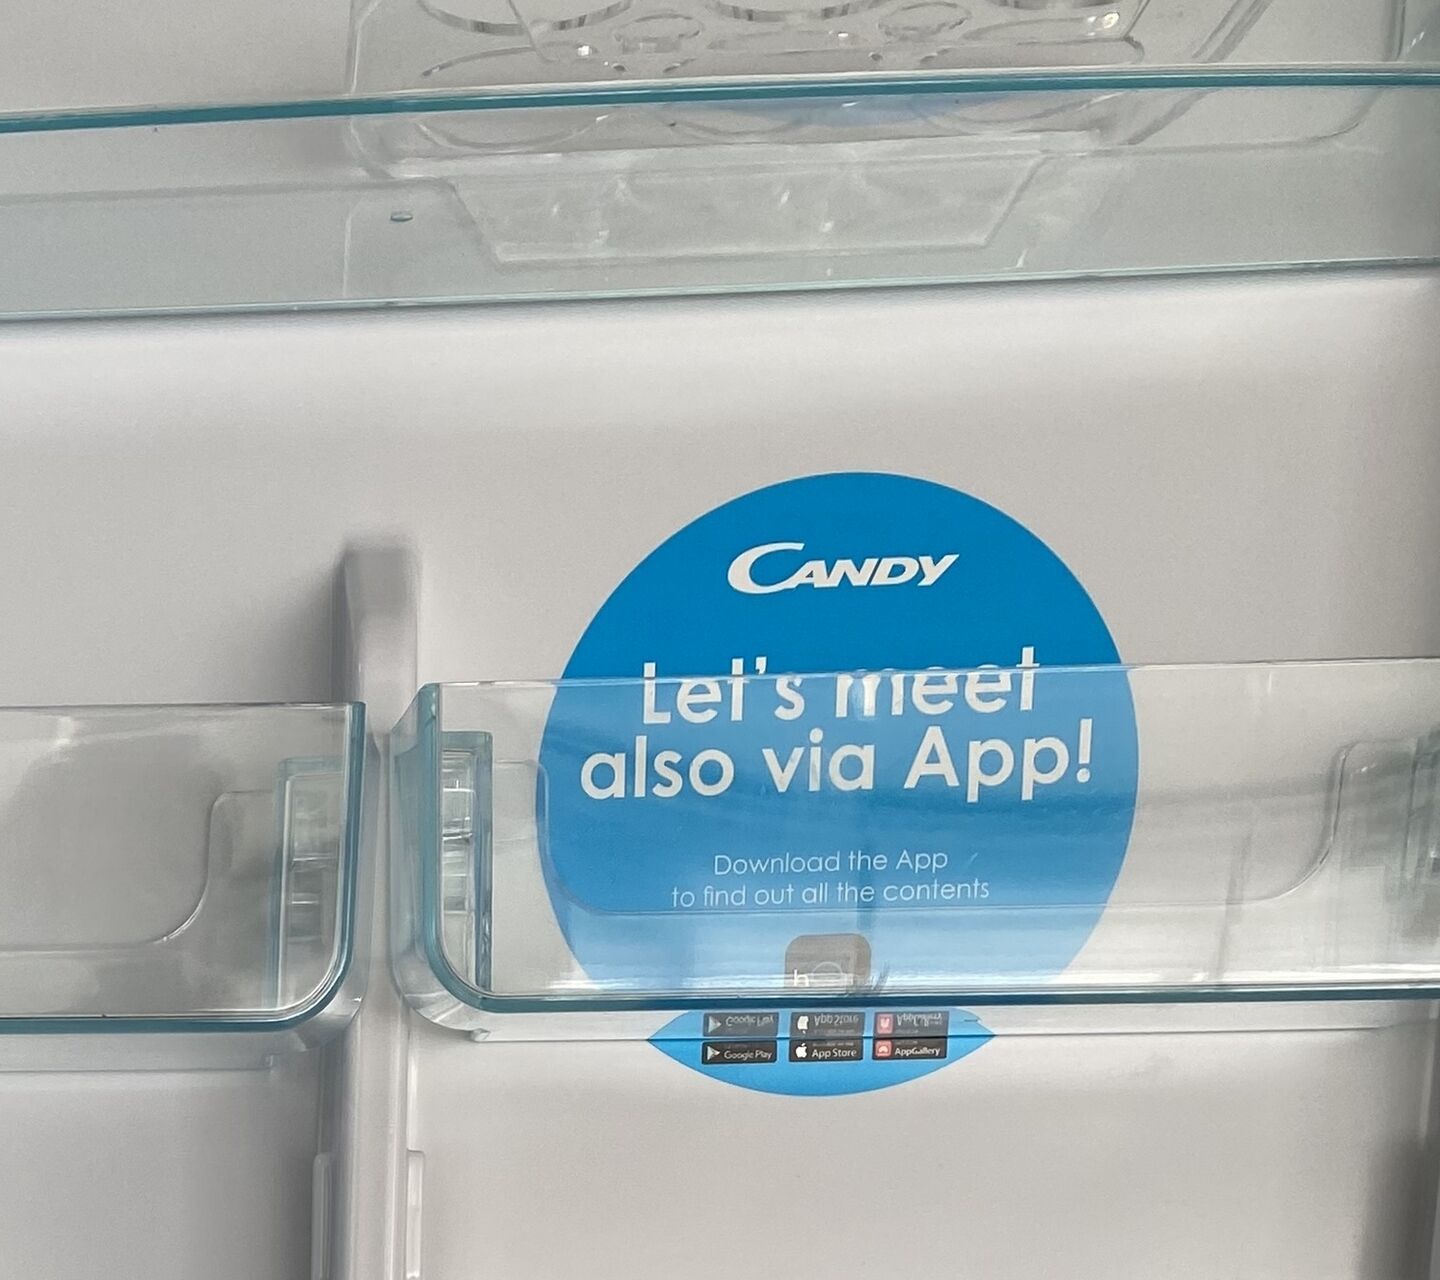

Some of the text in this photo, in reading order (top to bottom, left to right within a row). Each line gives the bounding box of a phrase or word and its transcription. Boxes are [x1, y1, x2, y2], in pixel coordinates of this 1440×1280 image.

[727, 542, 960, 595] CANDY
[643, 646, 1040, 725] Let's meet
[580, 718, 1093, 803] also via App!
[714, 849, 949, 876] Download the App
[671, 878, 990, 908] to find out all the contents
[723, 1049, 773, 1061] Google Play
[812, 1048, 857, 1060] App Store
[894, 1046, 941, 1057] AppGallery
